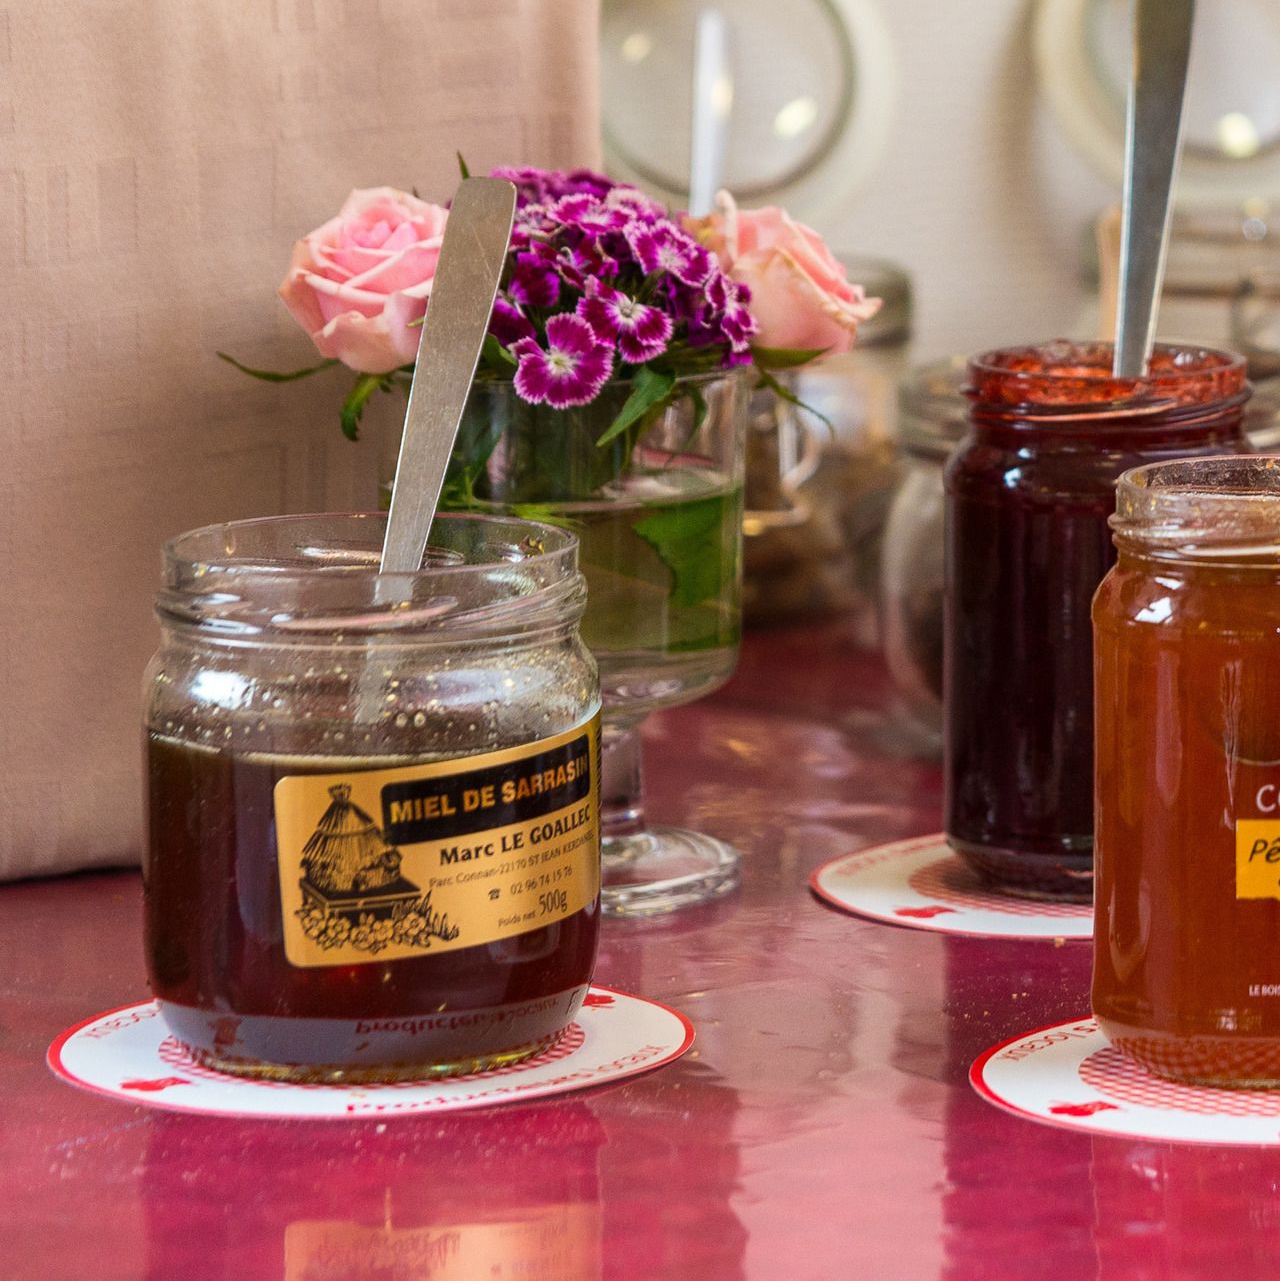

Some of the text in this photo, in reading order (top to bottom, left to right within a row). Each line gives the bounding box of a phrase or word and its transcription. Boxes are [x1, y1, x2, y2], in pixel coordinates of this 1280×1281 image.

[390, 793, 456, 824] MIEL
[463, 784, 496, 813] DE
[440, 804, 591, 866] Marc LE GOALLEC
[429, 877, 454, 889] Parc
[528, 853, 540, 866] ST
[541, 846, 561, 862] JEAN
[539, 888, 568, 917] 500g
[1249, 984, 1260, 997] LE
[346, 1072, 595, 1112] Producteurs
